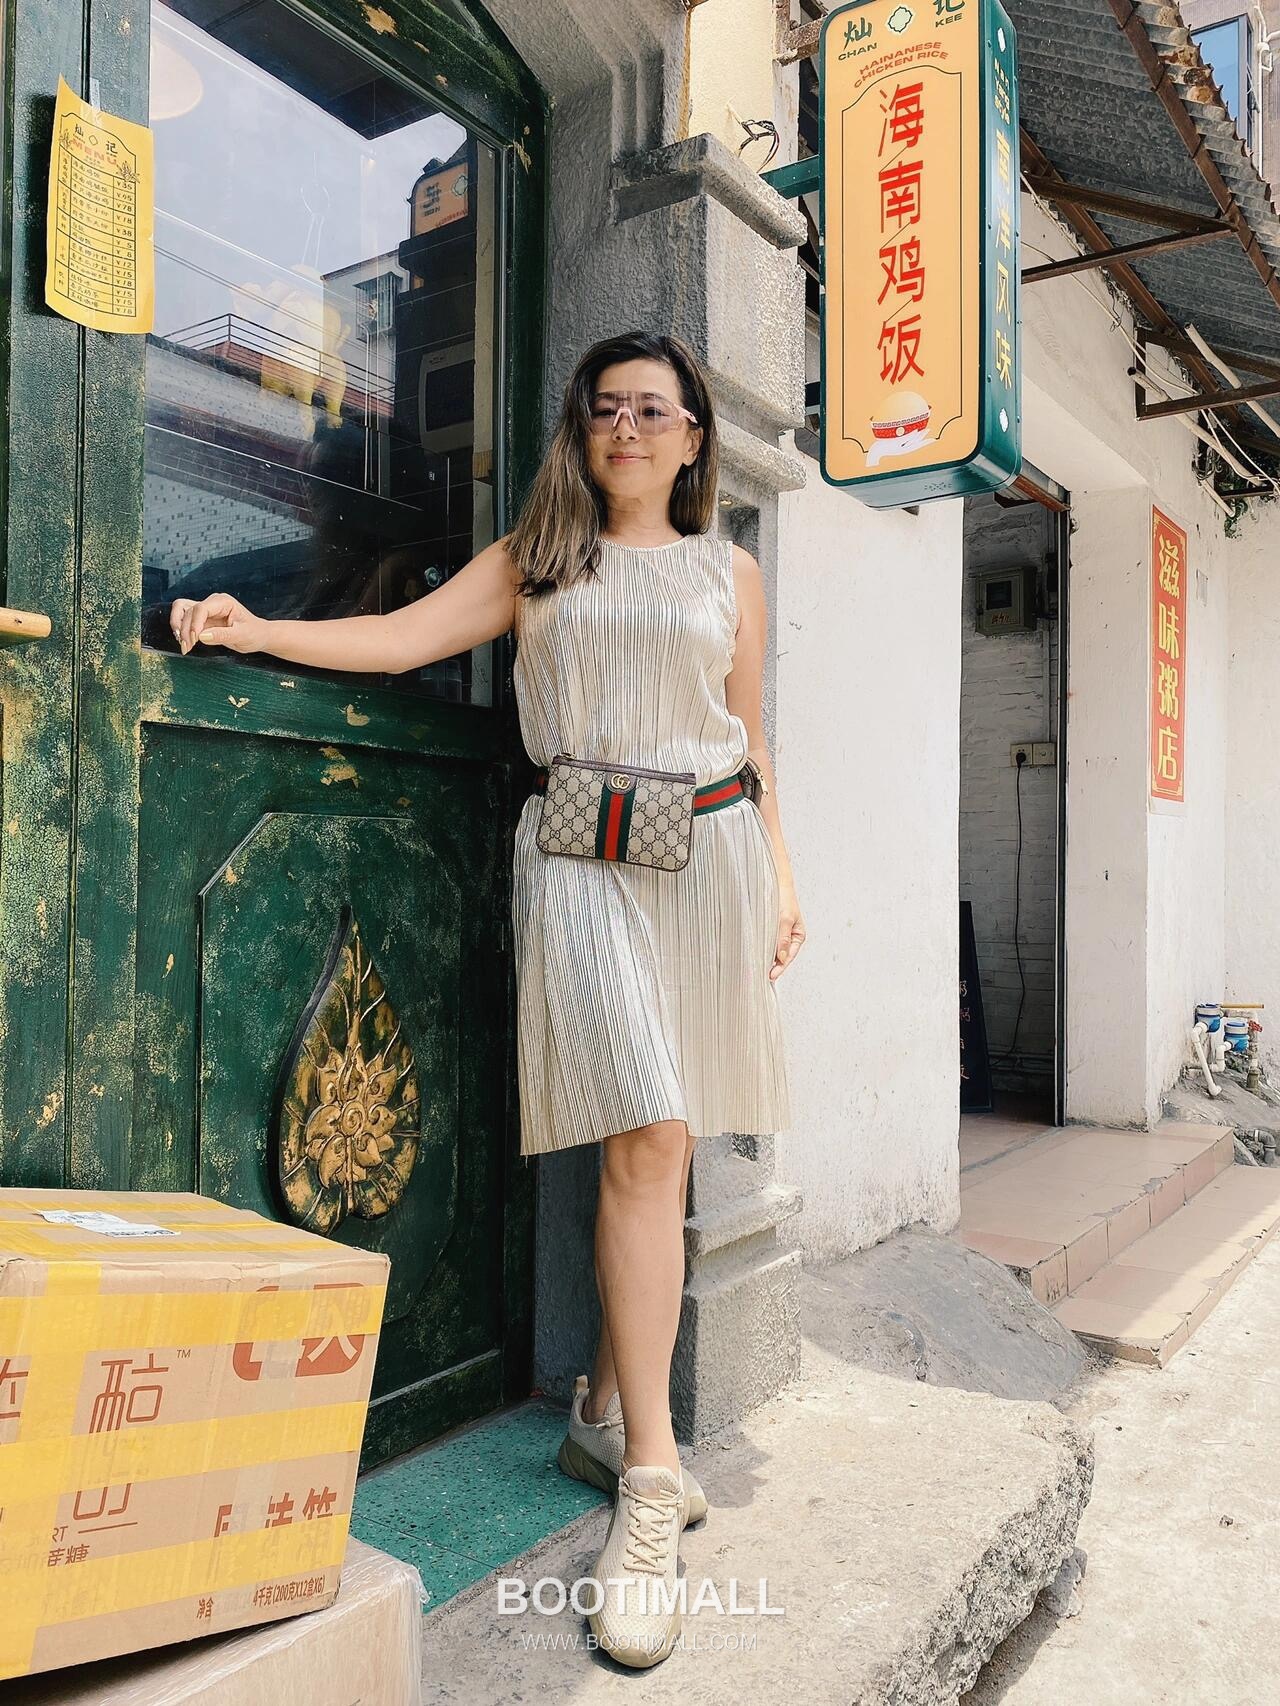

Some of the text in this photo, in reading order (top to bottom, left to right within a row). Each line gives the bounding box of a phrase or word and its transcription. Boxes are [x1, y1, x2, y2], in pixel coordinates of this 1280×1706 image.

[838, 13, 963, 61] CHAN KEE
[843, 17, 873, 50] 灿
[853, 51, 950, 89] CHICKEN RICE
[859, 41, 943, 75] HAINANESE
[71, 138, 117, 165] MENU
[876, 80, 926, 386] 海南鸡饭
[1157, 534, 1181, 781] 滋味粥店
[176, 1349, 191, 1359] TM
